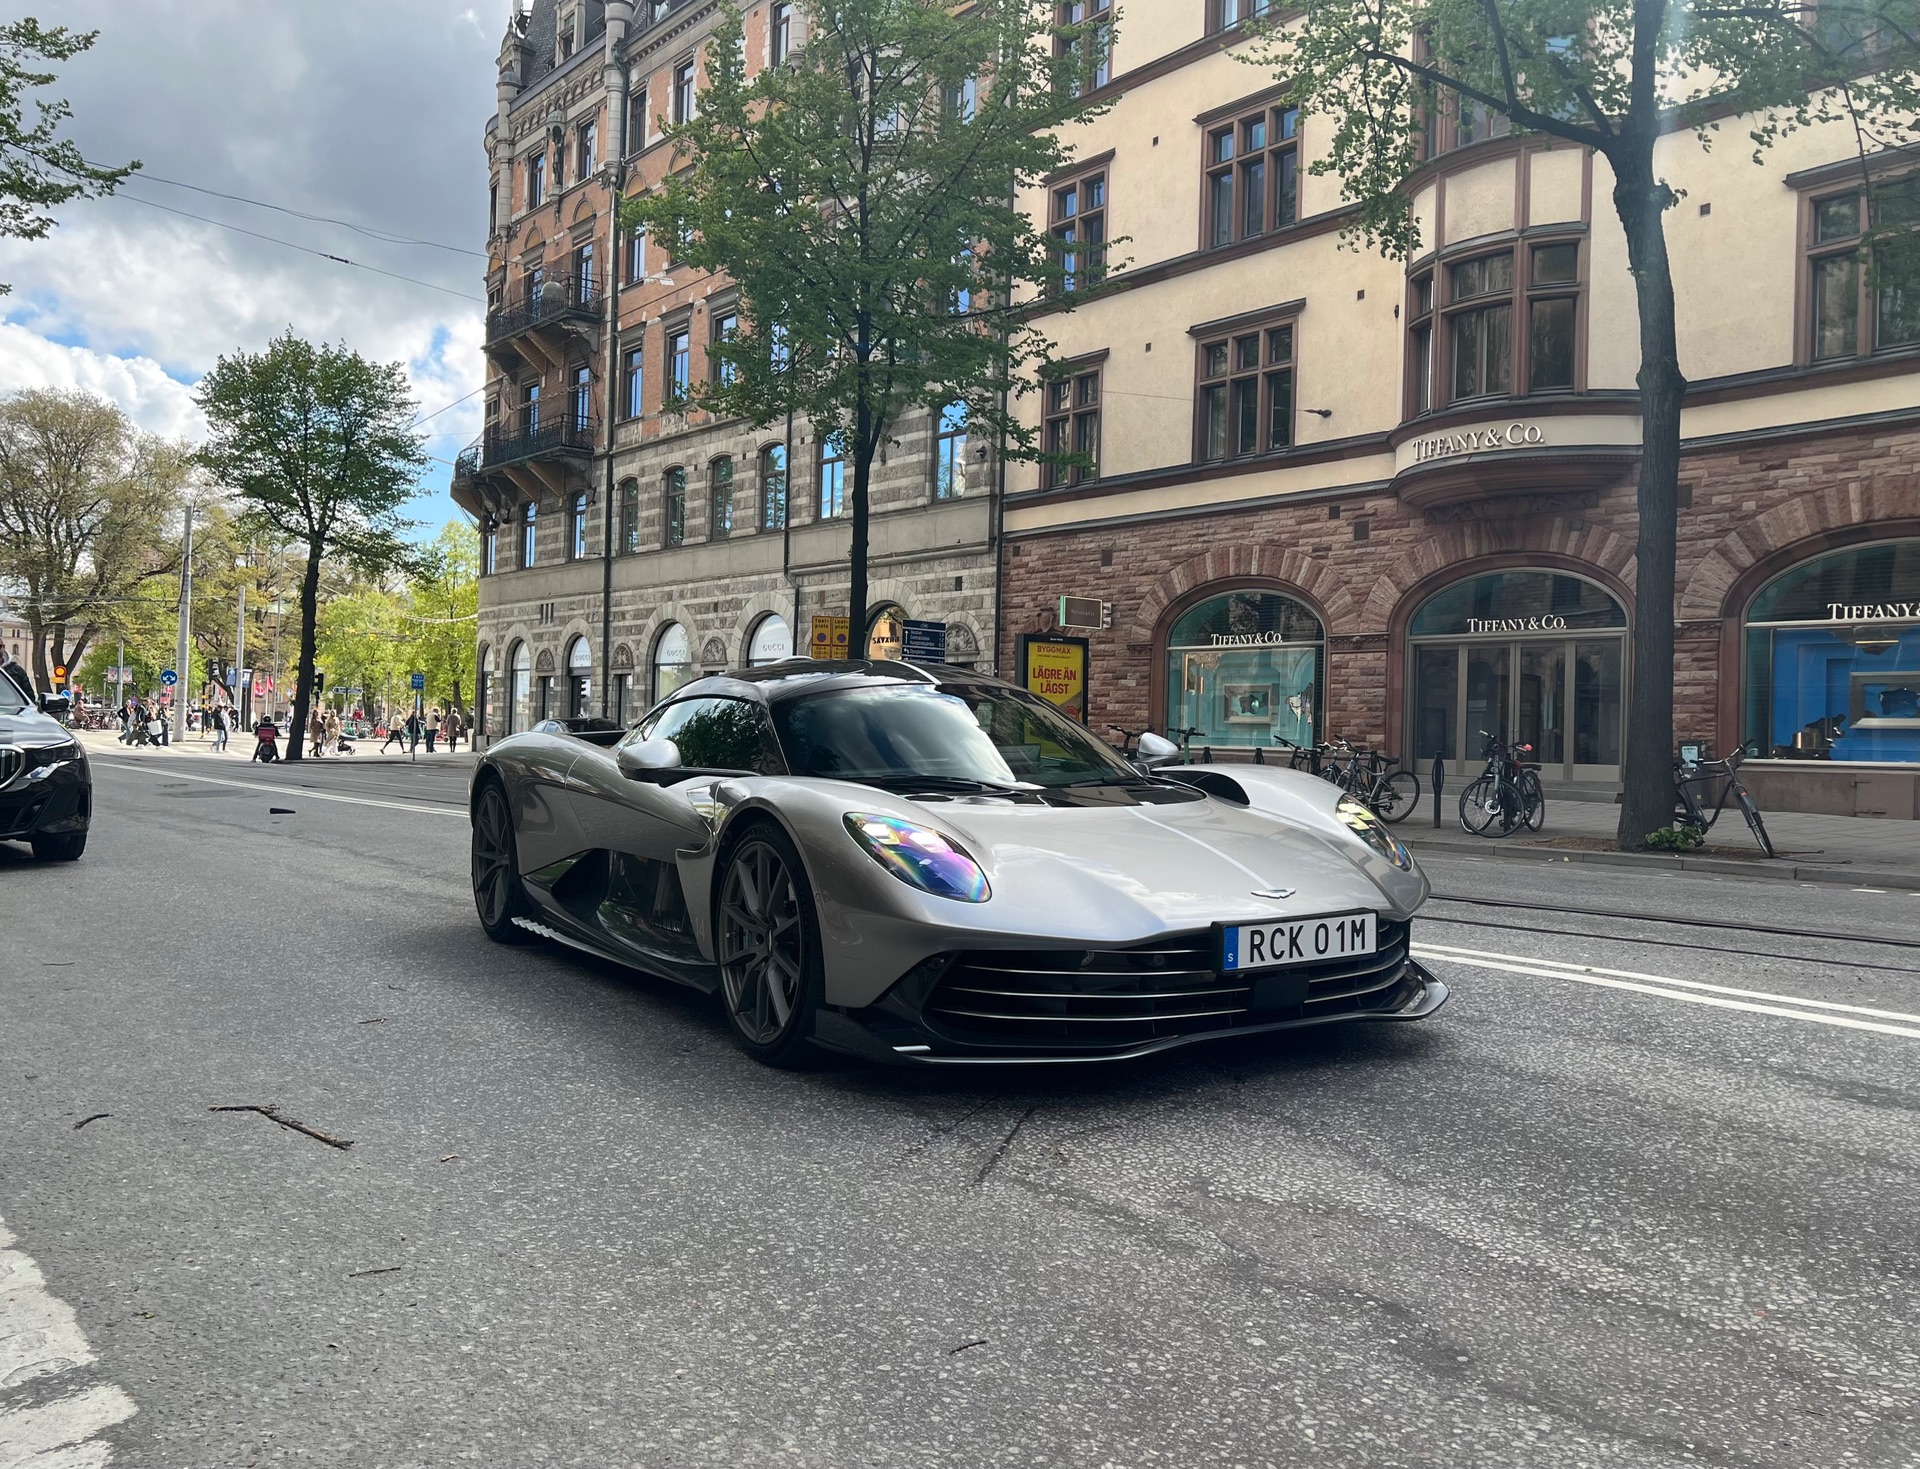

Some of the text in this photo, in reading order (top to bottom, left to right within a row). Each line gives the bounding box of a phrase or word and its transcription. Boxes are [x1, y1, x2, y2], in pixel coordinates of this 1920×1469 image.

[763, 643, 784, 652] GUCCI
[1037, 645, 1071, 654] BYGGMAX
[1032, 665, 1077, 681] LÄGRE ÄN
[1040, 680, 1069, 694] LÄGST
[1227, 952, 1234, 963] S
[1249, 925, 1304, 963] RCK
